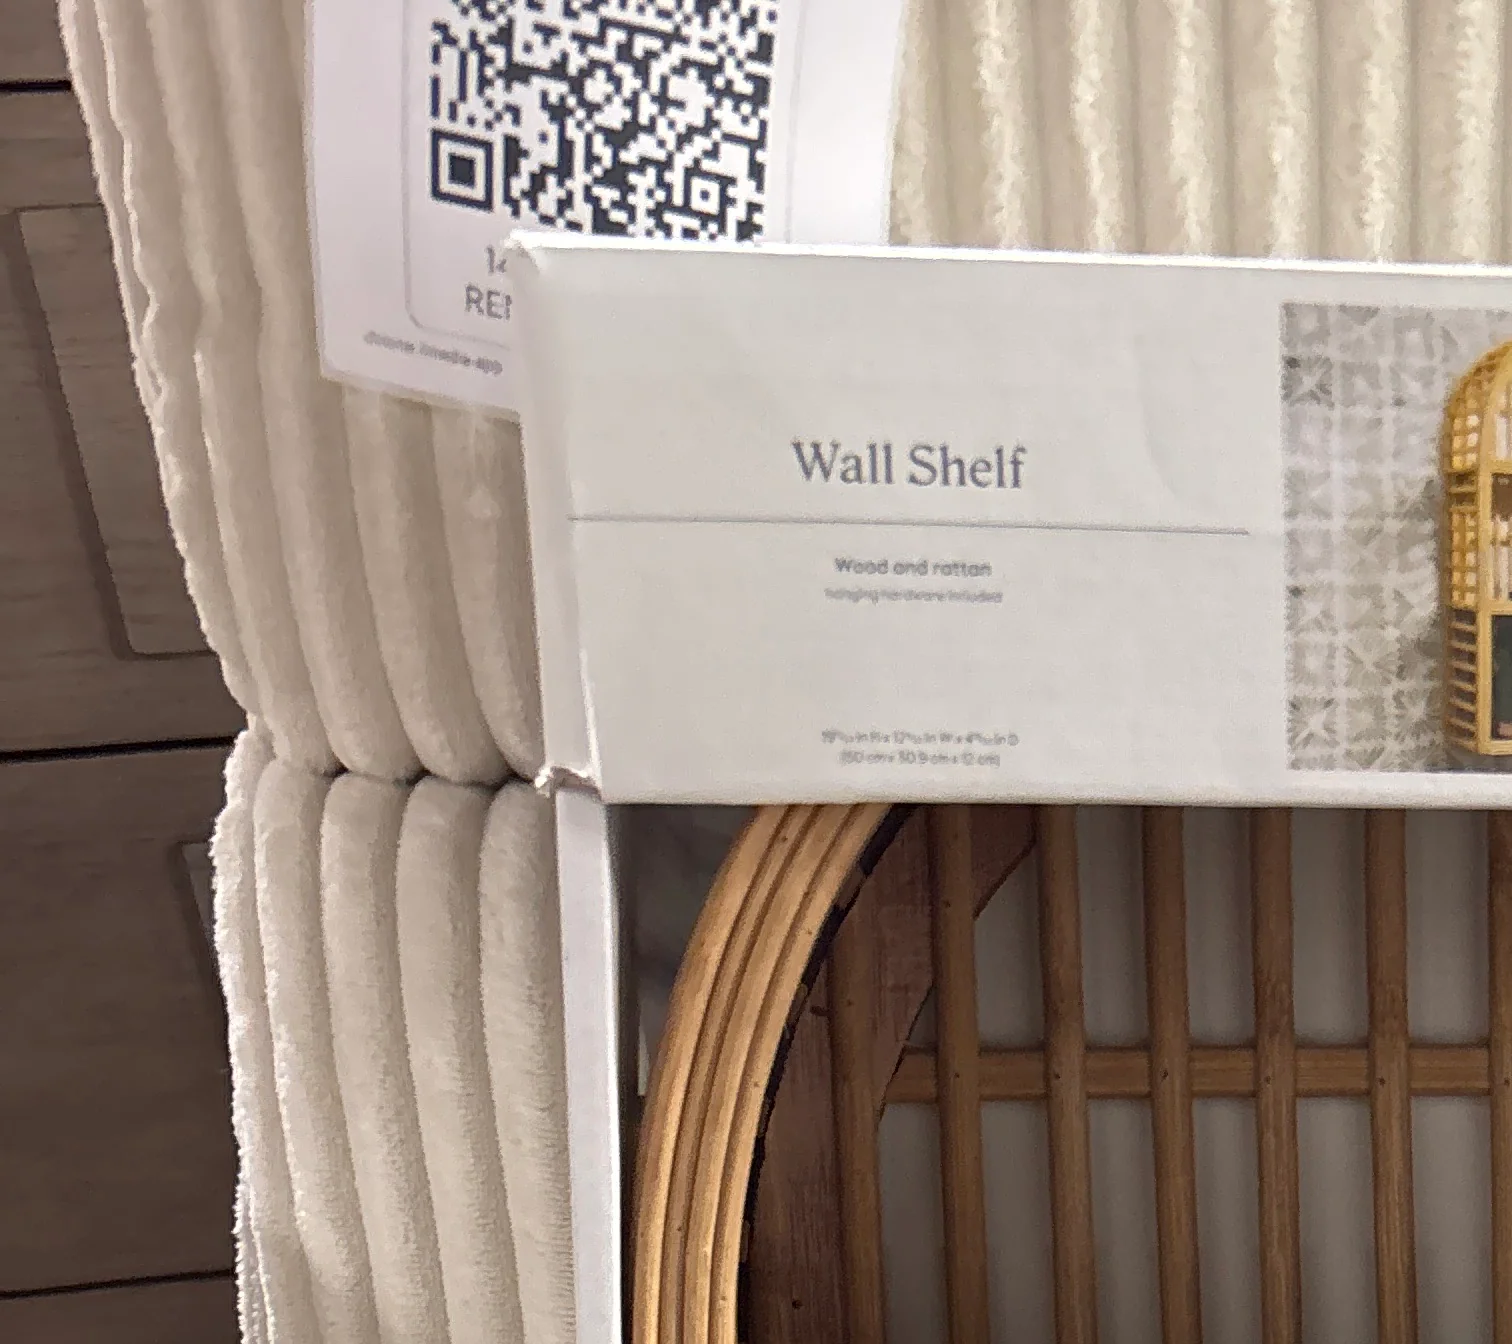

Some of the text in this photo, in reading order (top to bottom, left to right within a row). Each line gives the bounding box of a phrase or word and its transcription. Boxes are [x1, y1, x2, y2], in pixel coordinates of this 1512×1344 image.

[791, 440, 1028, 489] Wall Shelf
[834, 557, 889, 575] Wood
[893, 559, 929, 576] and
